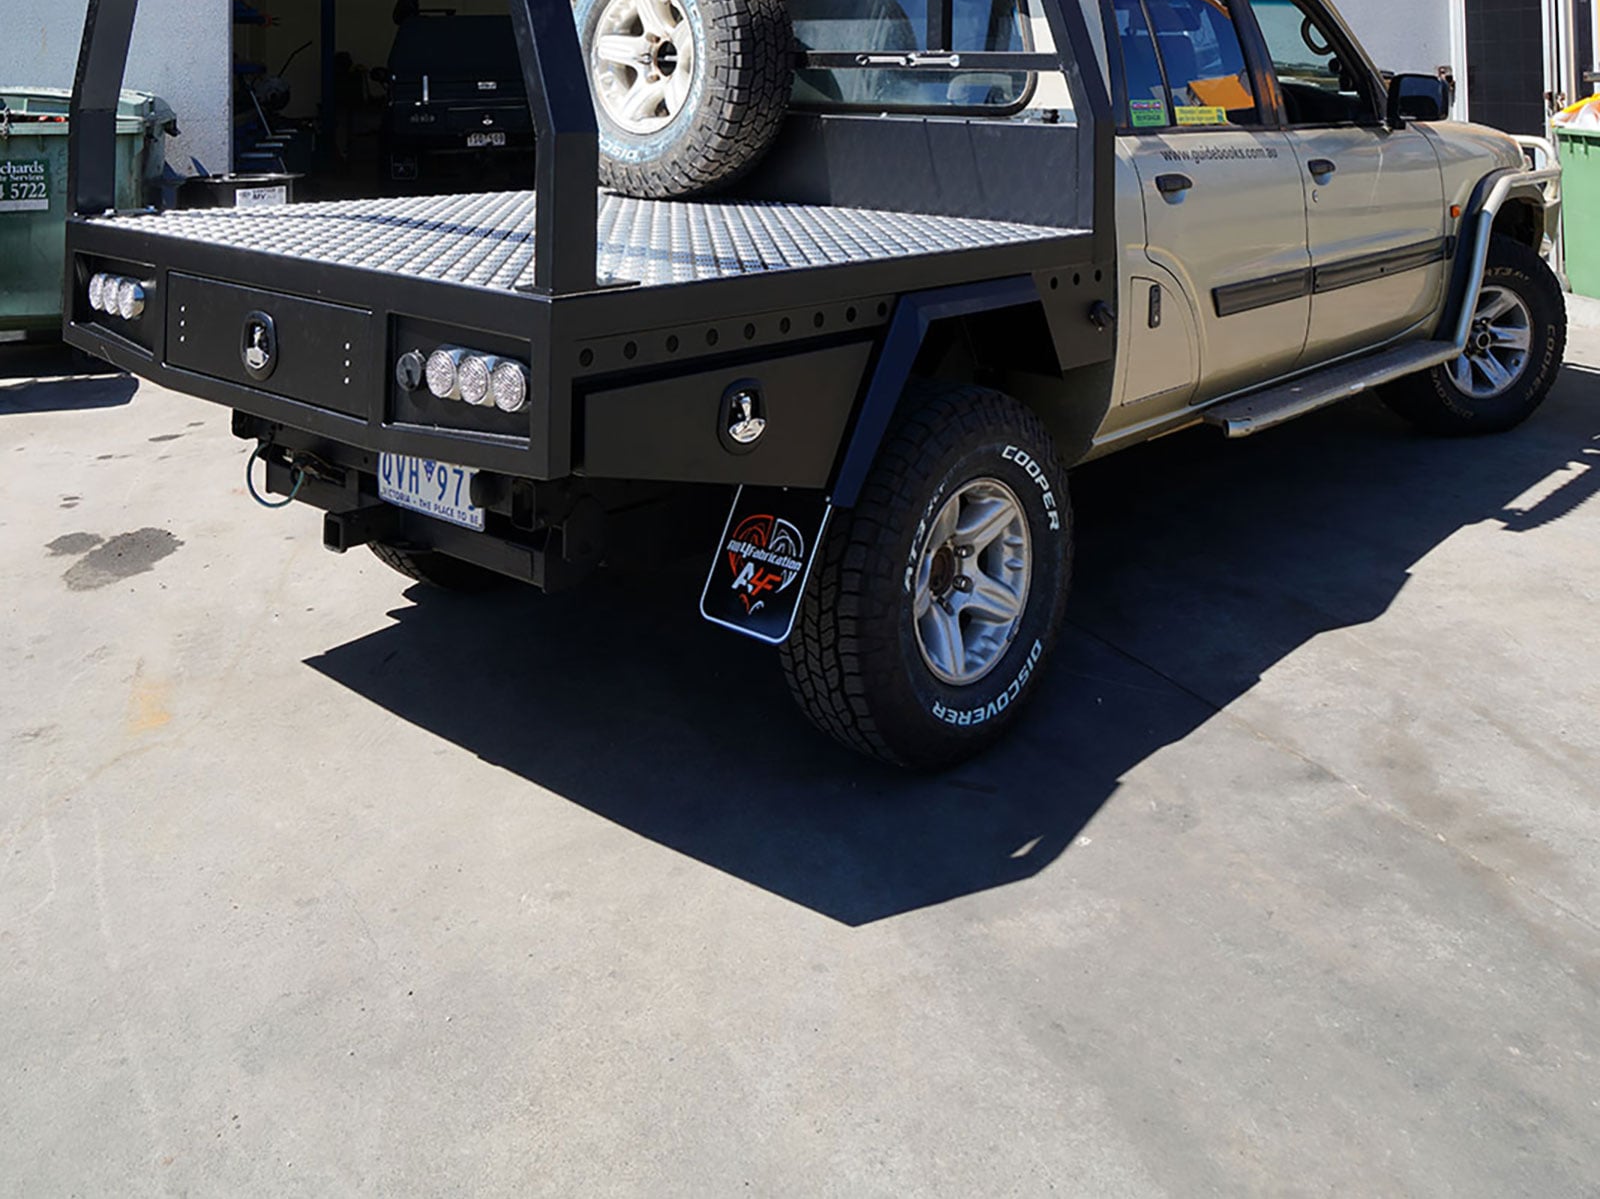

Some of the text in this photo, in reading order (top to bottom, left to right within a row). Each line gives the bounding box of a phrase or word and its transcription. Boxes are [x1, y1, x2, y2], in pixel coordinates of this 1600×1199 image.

[10, 182, 47, 199] 5722
[382, 452, 476, 511] QVH 97
[1002, 445, 1060, 531] COOPER
[932, 638, 1043, 726] DISCOVERER
